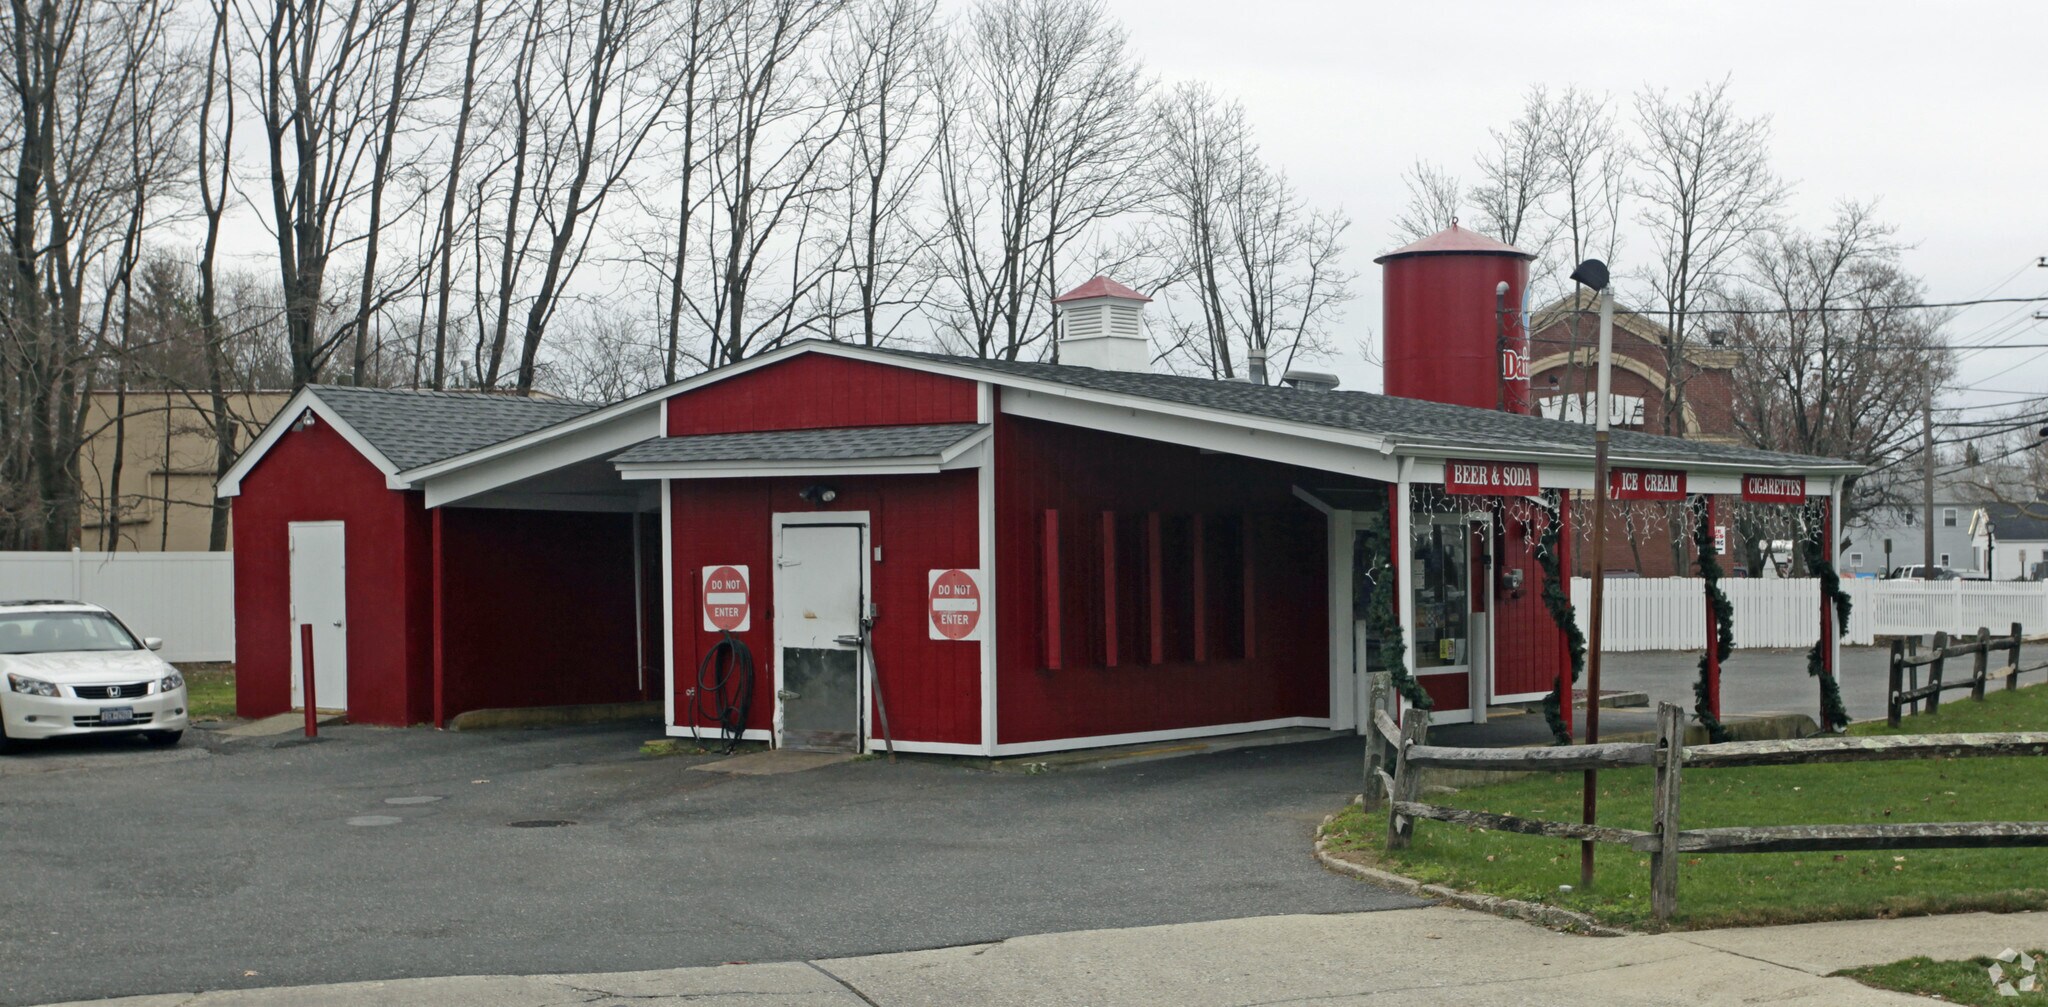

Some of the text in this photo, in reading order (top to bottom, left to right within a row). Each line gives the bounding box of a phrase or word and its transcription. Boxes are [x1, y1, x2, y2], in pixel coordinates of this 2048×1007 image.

[1539, 391, 1645, 426] VALUE
[1454, 465, 1532, 486] BEER & SODA
[1622, 472, 1678, 492] ICE CREAM
[1749, 477, 1801, 496] CIGARETTES
[711, 580, 741, 590] DO NOT
[939, 585, 971, 595] DO NOT
[714, 607, 739, 617] ENTER
[941, 614, 969, 624] ENTER
